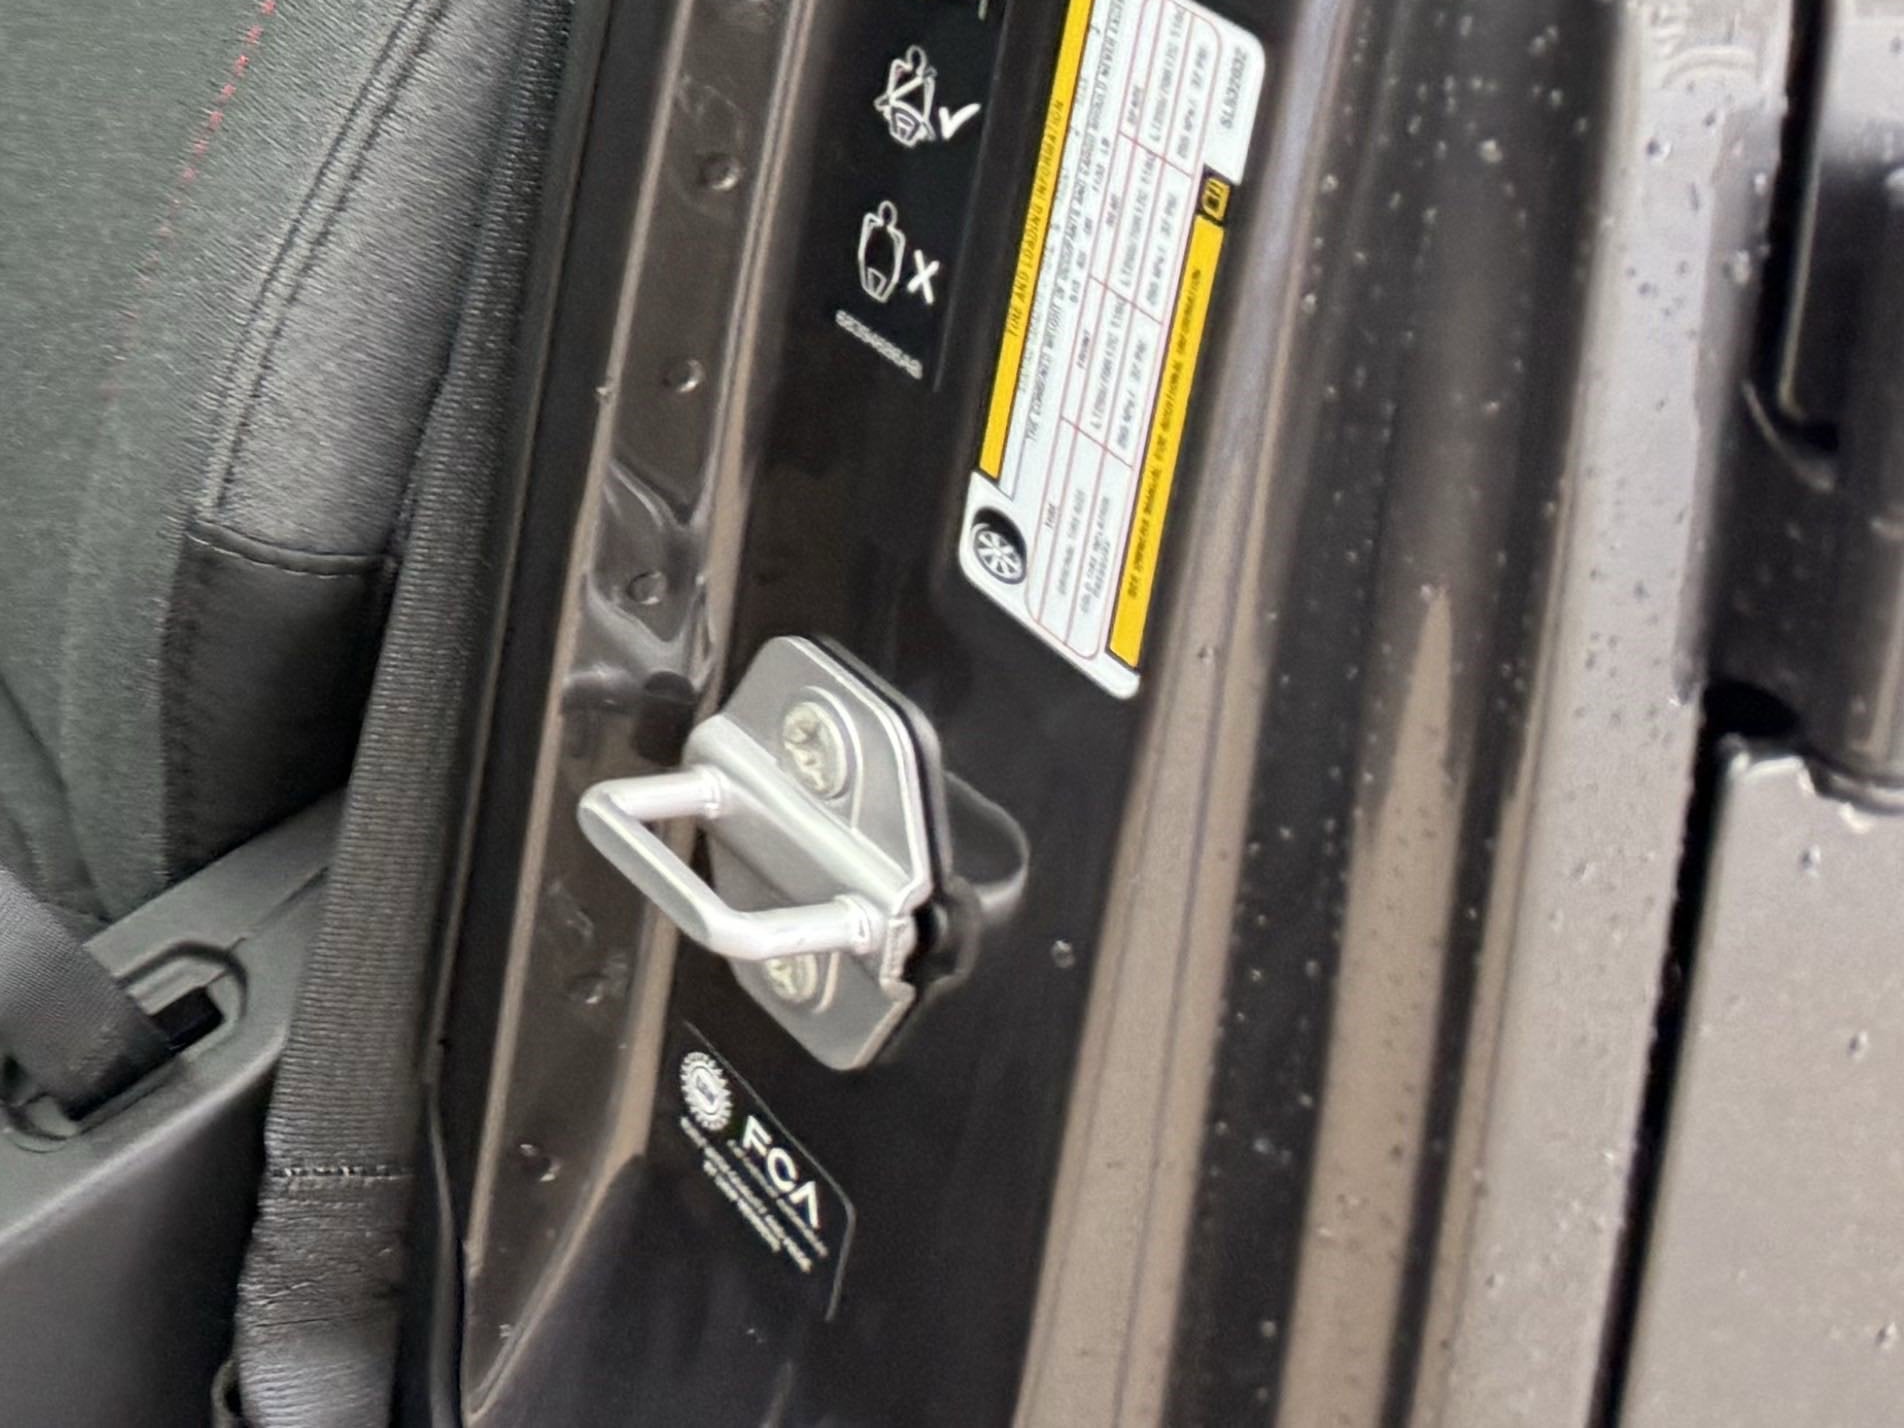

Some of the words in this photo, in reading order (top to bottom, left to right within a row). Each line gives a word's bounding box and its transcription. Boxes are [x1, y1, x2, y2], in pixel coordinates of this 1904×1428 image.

[1033, 96, 1064, 201] INFORMATION
[1019, 200, 1043, 269] LOADING
[1013, 267, 1030, 304] AND
[1006, 302, 1023, 339] TIRE
[743, 1115, 820, 1229] FCA
